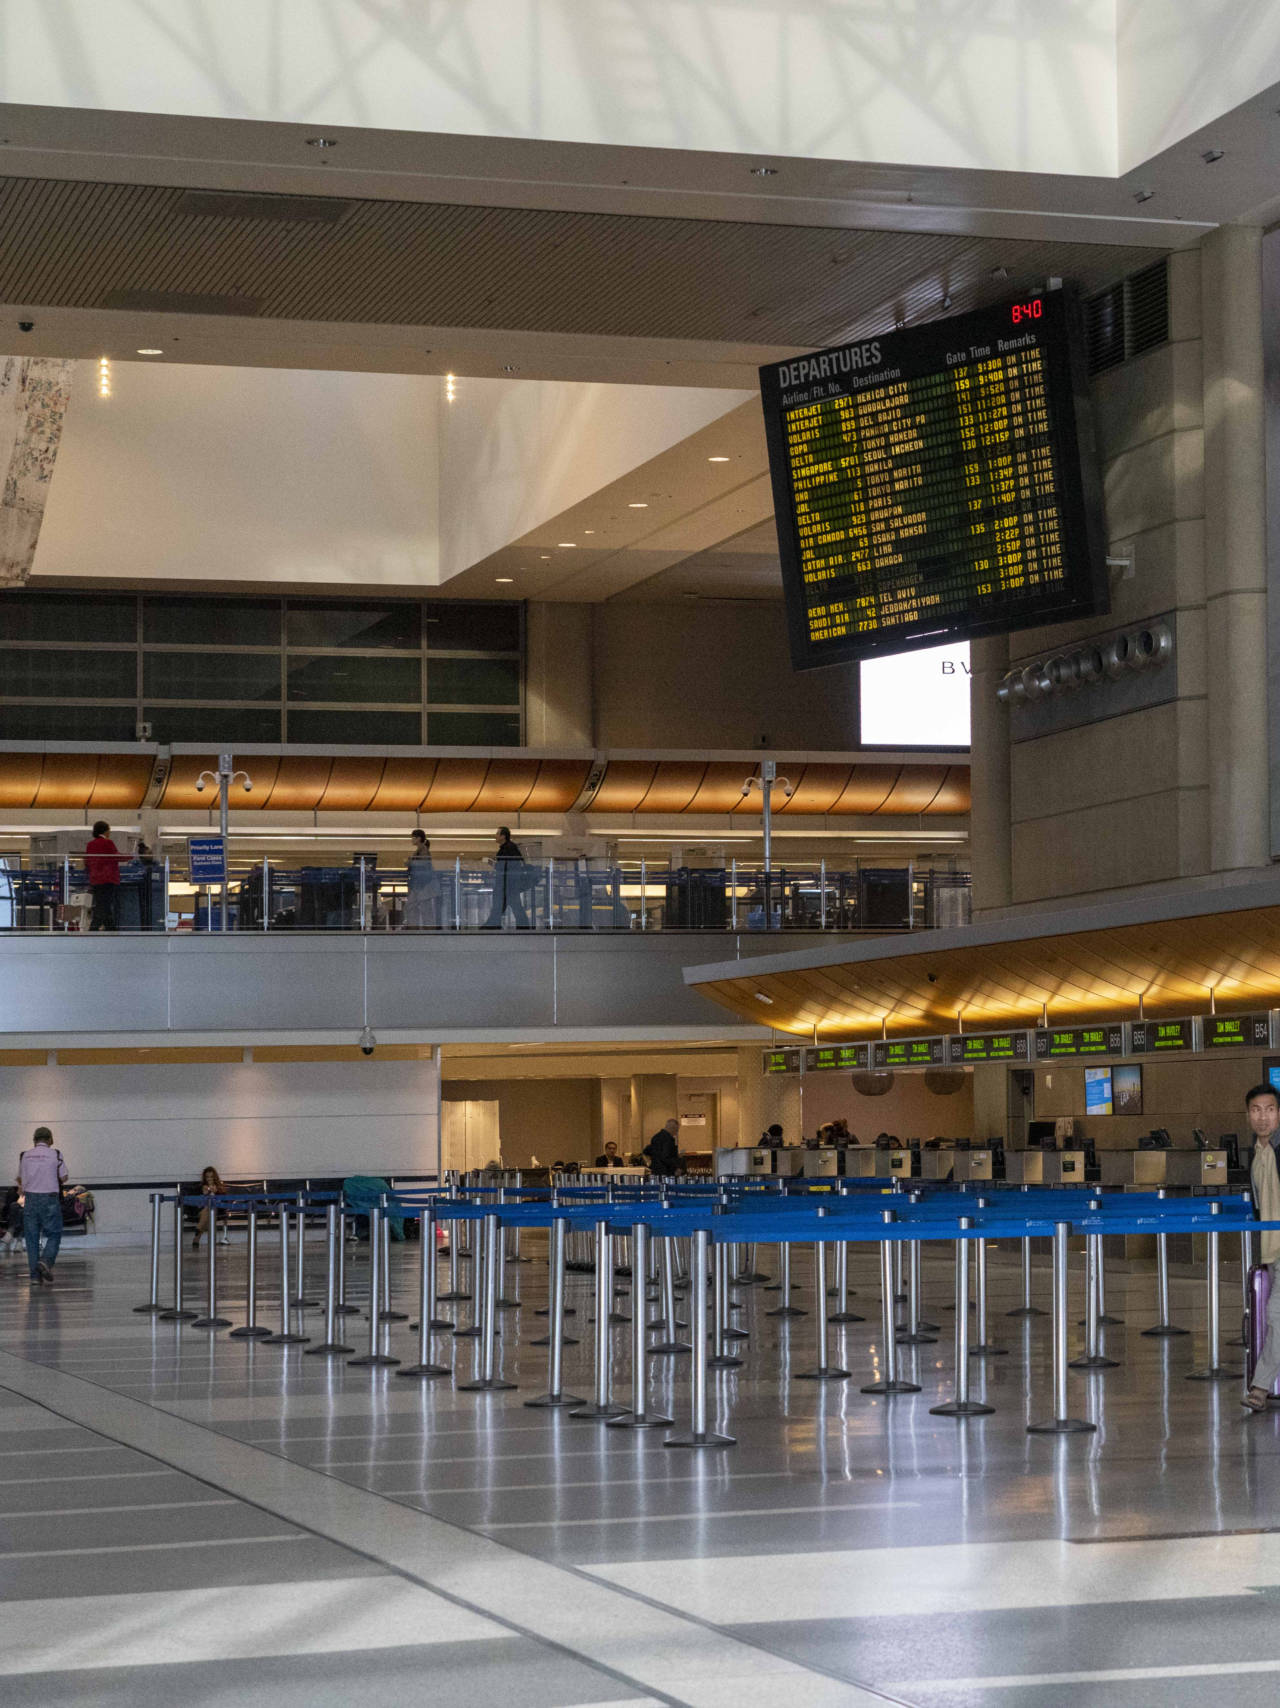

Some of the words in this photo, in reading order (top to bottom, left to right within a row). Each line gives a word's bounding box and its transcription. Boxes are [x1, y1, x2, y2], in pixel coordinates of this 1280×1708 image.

[1012, 299, 1042, 323] 8:40
[779, 342, 881, 388] DEPARTURES
[852, 367, 901, 388] Destination
[946, 351, 967, 365] Gate
[969, 345, 991, 359] Time
[998, 333, 1037, 352] Remarks
[786, 403, 821, 421] INTERJET
[833, 395, 852, 409] 2971
[856, 387, 885, 403] MEXICO
[888, 381, 907, 395] CITY
[977, 357, 1002, 373] 9:30A
[787, 415, 822, 433] INTERJET
[955, 378, 970, 391] 159
[978, 369, 1003, 385] 9:40A
[1007, 366, 1018, 377] ON
[1021, 359, 1042, 374] TIME
[788, 428, 820, 444] VOLARIS
[789, 442, 808, 456] COPA
[891, 417, 911, 431] CITY
[915, 413, 925, 425] PA
[790, 453, 814, 468] DELTA
[862, 436, 885, 450] TOKYO
[978, 406, 1007, 422] 11:27A
[792, 460, 832, 479] SINGAPORE
[863, 448, 886, 462] SEOUL
[890, 439, 923, 455] INCHEON
[979, 418, 1008, 434] 12:00P
[793, 471, 838, 491] PHILIPPINE
[846, 466, 860, 478] 113
[864, 458, 892, 474] MANILA
[981, 430, 1010, 446] 12:15P
[794, 490, 808, 502] ANA
[866, 471, 889, 485] TOKYO
[892, 464, 921, 479] NARITA
[795, 502, 809, 514] JAL
[867, 483, 891, 497] TOKYO
[894, 475, 923, 491] NARITA
[988, 454, 1012, 469] 1:00P
[797, 511, 820, 525] DELTA
[868, 495, 892, 509] PARIS
[989, 466, 1013, 481] 1:34P
[799, 536, 814, 548] AIR
[817, 529, 845, 544] CANADA
[848, 525, 867, 538] 6456
[889, 511, 926, 528] SALVADOR
[991, 491, 1016, 505] 1:40P
[798, 521, 830, 537] VOLARIS
[851, 513, 866, 525] 929
[801, 548, 815, 560] JAL
[872, 530, 895, 544] OSAKA
[899, 523, 927, 538] KANSAI
[802, 558, 825, 571] LATAM
[993, 515, 1018, 530] 2:00P
[996, 539, 1021, 554] 2:50P
[803, 567, 835, 583] VOLARIS
[998, 551, 1022, 566] 3:00P
[807, 605, 826, 618] AERO
[879, 591, 892, 603] TEL
[896, 586, 916, 599] AVIV
[999, 563, 1023, 578] 3:00P
[809, 616, 831, 629] SAUDI
[835, 612, 849, 624] AIR
[1000, 576, 1025, 590] 3:00P
[810, 625, 846, 641] AMERICAN
[881, 610, 918, 627] SANTIAGO
[1255, 1023, 1268, 1039] B54
